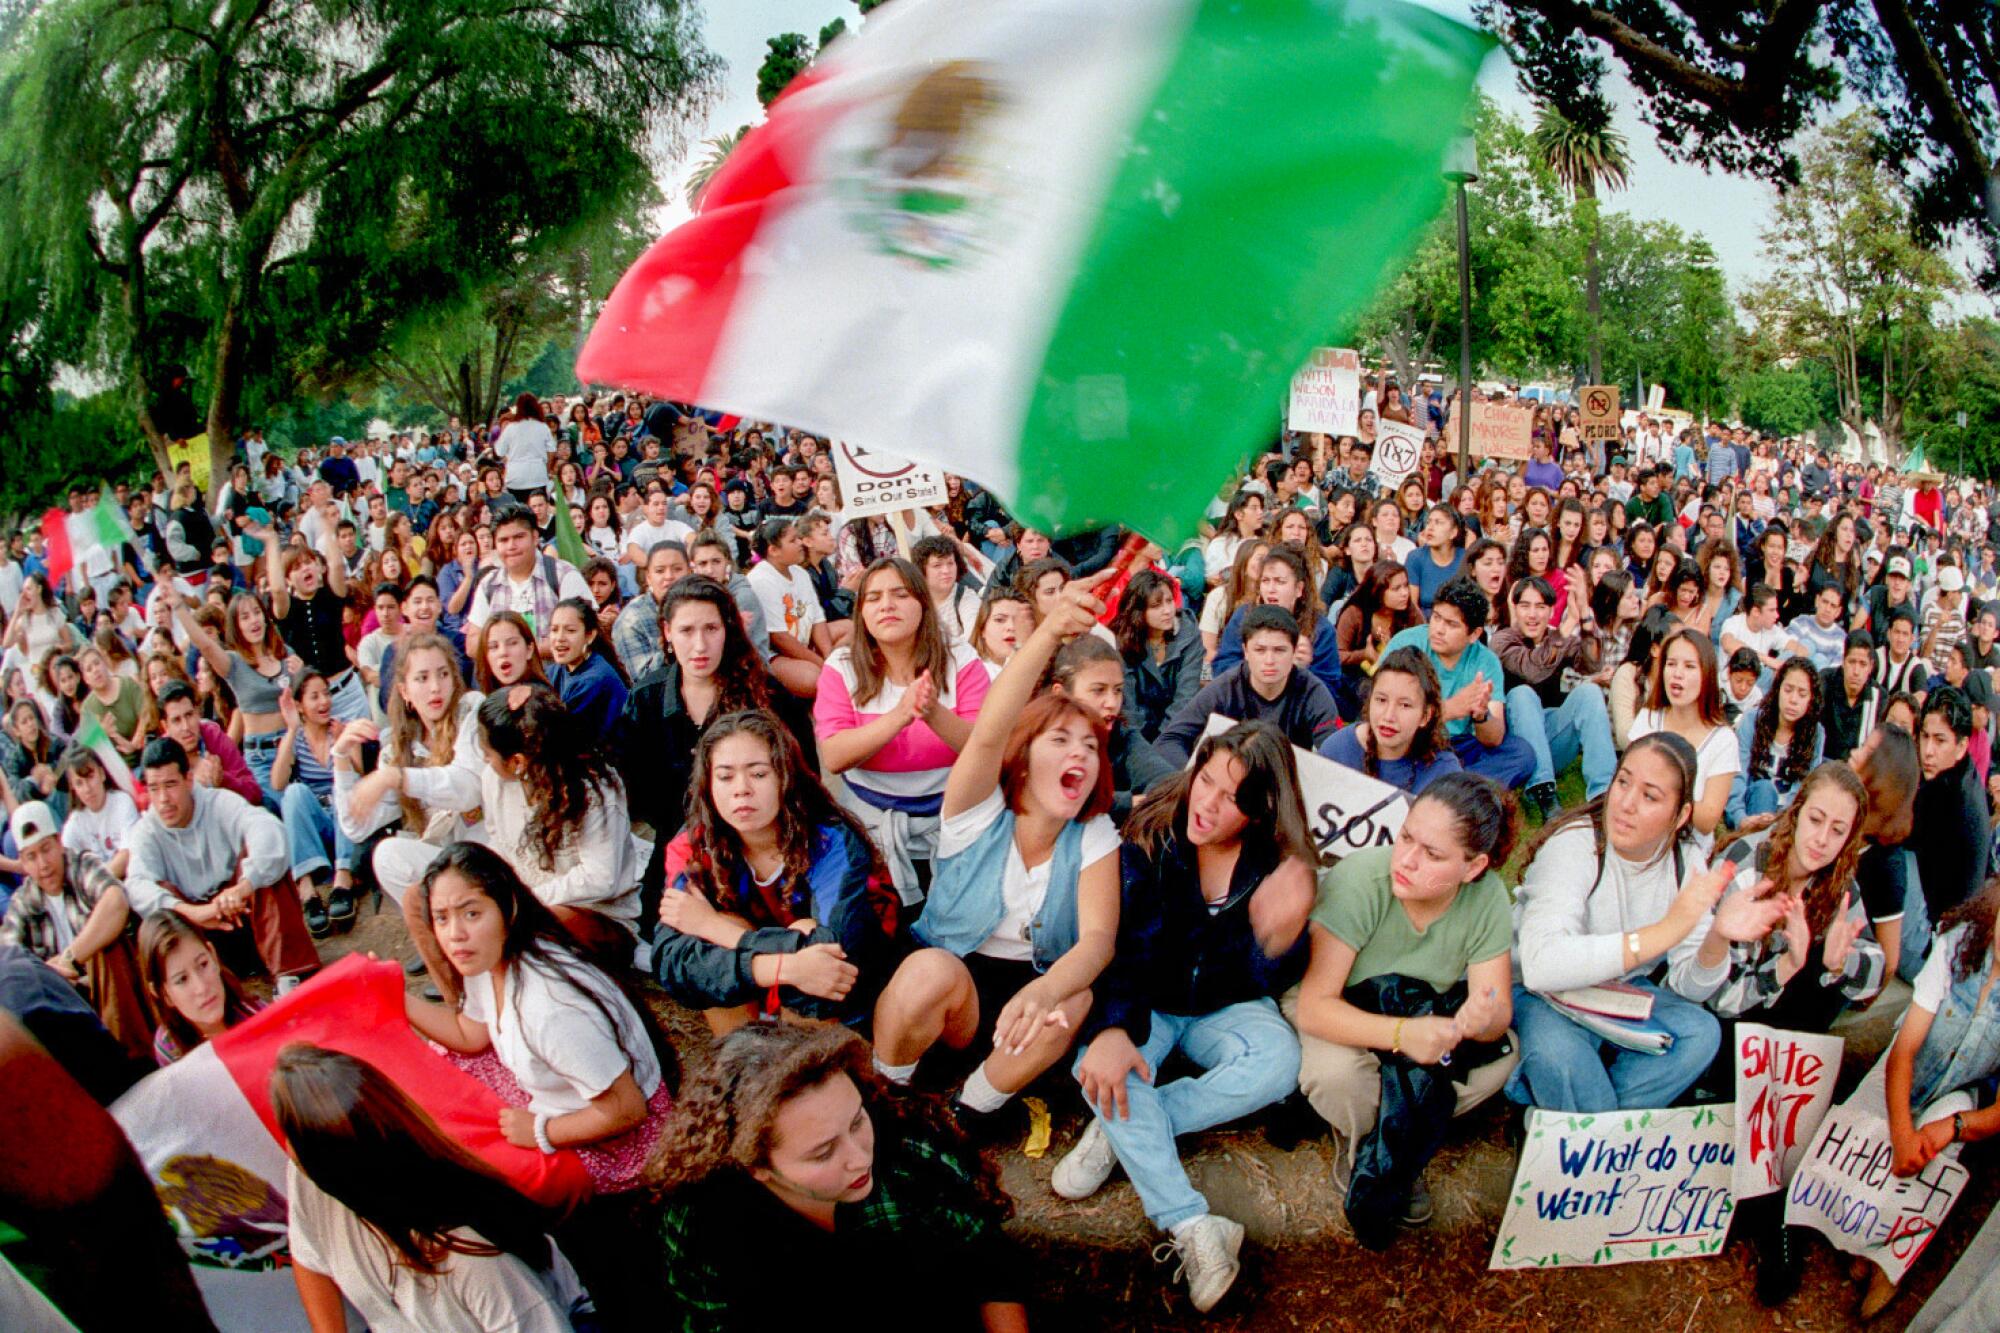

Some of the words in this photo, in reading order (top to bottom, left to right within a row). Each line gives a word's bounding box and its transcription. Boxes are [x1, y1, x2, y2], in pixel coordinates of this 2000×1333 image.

[1293, 379, 1335, 397] WILSON
[1472, 422, 1521, 440] MADRE
[1585, 425, 1617, 438] PEDRO
[857, 473, 930, 492] Don't
[1747, 1084, 1815, 1165] 187
[1560, 1136, 1643, 1178] What
[1646, 1135, 1677, 1172] do
[1679, 1142, 1735, 1190] you
[1609, 1185, 1731, 1237] JUSTICE
